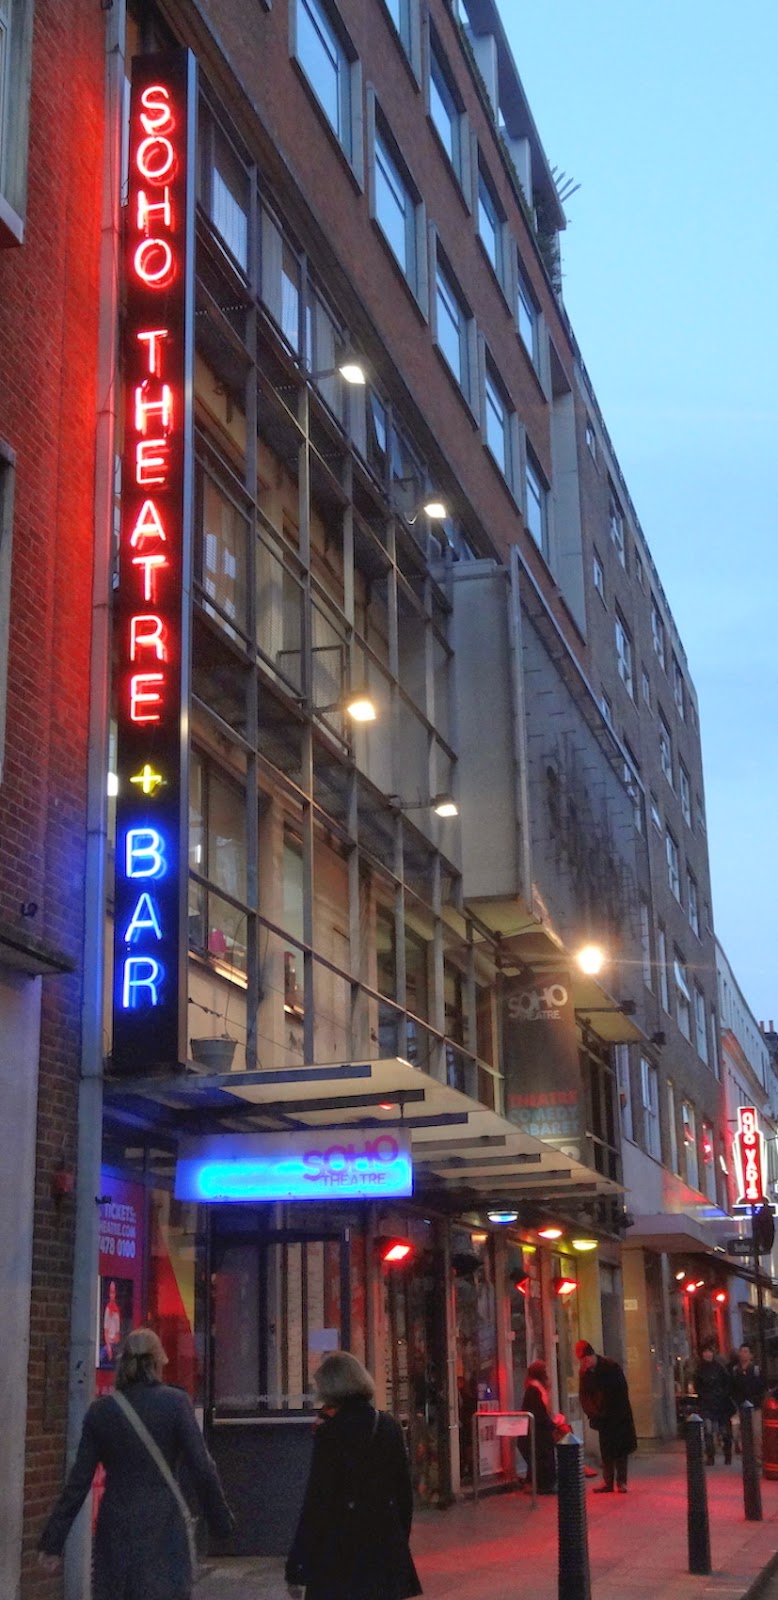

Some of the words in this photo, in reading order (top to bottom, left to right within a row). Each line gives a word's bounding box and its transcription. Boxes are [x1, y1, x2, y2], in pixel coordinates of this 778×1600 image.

[134, 85, 174, 282] SOHO
[129, 329, 171, 722] THEATRE
[130, 764, 162, 794] +
[123, 828, 163, 1009] BAR
[508, 984, 568, 1018] SOHO
[508, 1106, 579, 1123] COMEDY
[520, 1120, 578, 1136] ABARET
[302, 1134, 399, 1182] SOHO
[321, 1172, 387, 1187] THEATRE
